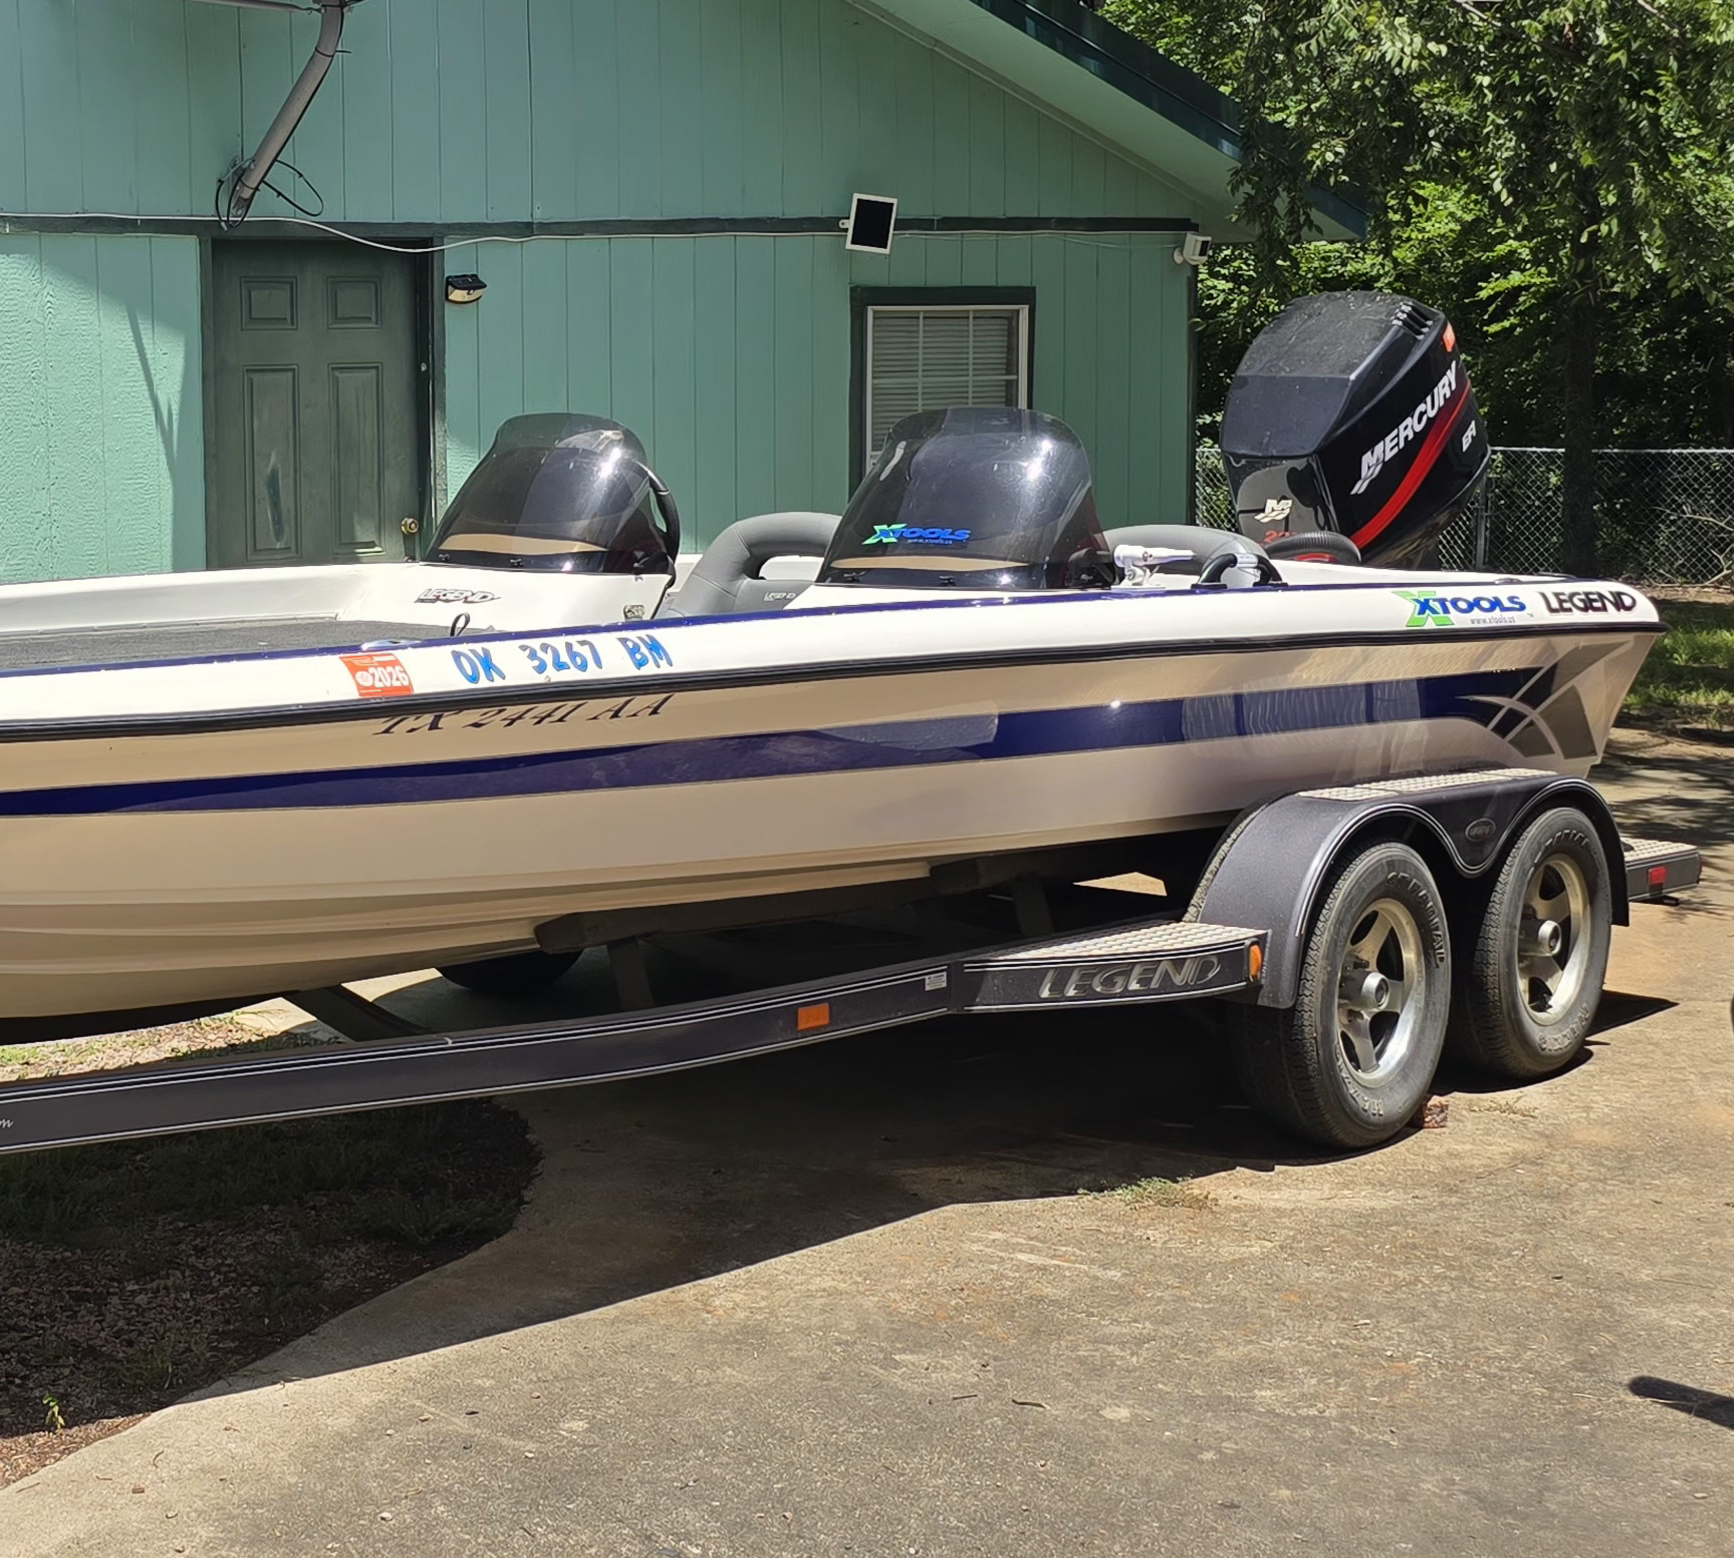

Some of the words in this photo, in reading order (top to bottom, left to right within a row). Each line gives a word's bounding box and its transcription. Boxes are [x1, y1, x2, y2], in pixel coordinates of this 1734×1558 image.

[1350, 361, 1457, 495] MERCURY
[414, 588, 498, 604] LEGEND
[1392, 590, 1527, 627] XTOOLS
[1538, 590, 1637, 614] LEGEND
[368, 665, 410, 688] 2026
[450, 646, 506, 684] OK
[518, 639, 603, 674] 3267
[616, 633, 674, 670] BM
[372, 709, 464, 736] TX
[462, 701, 589, 729] 2441
[1039, 956, 1222, 998] LEGEND
